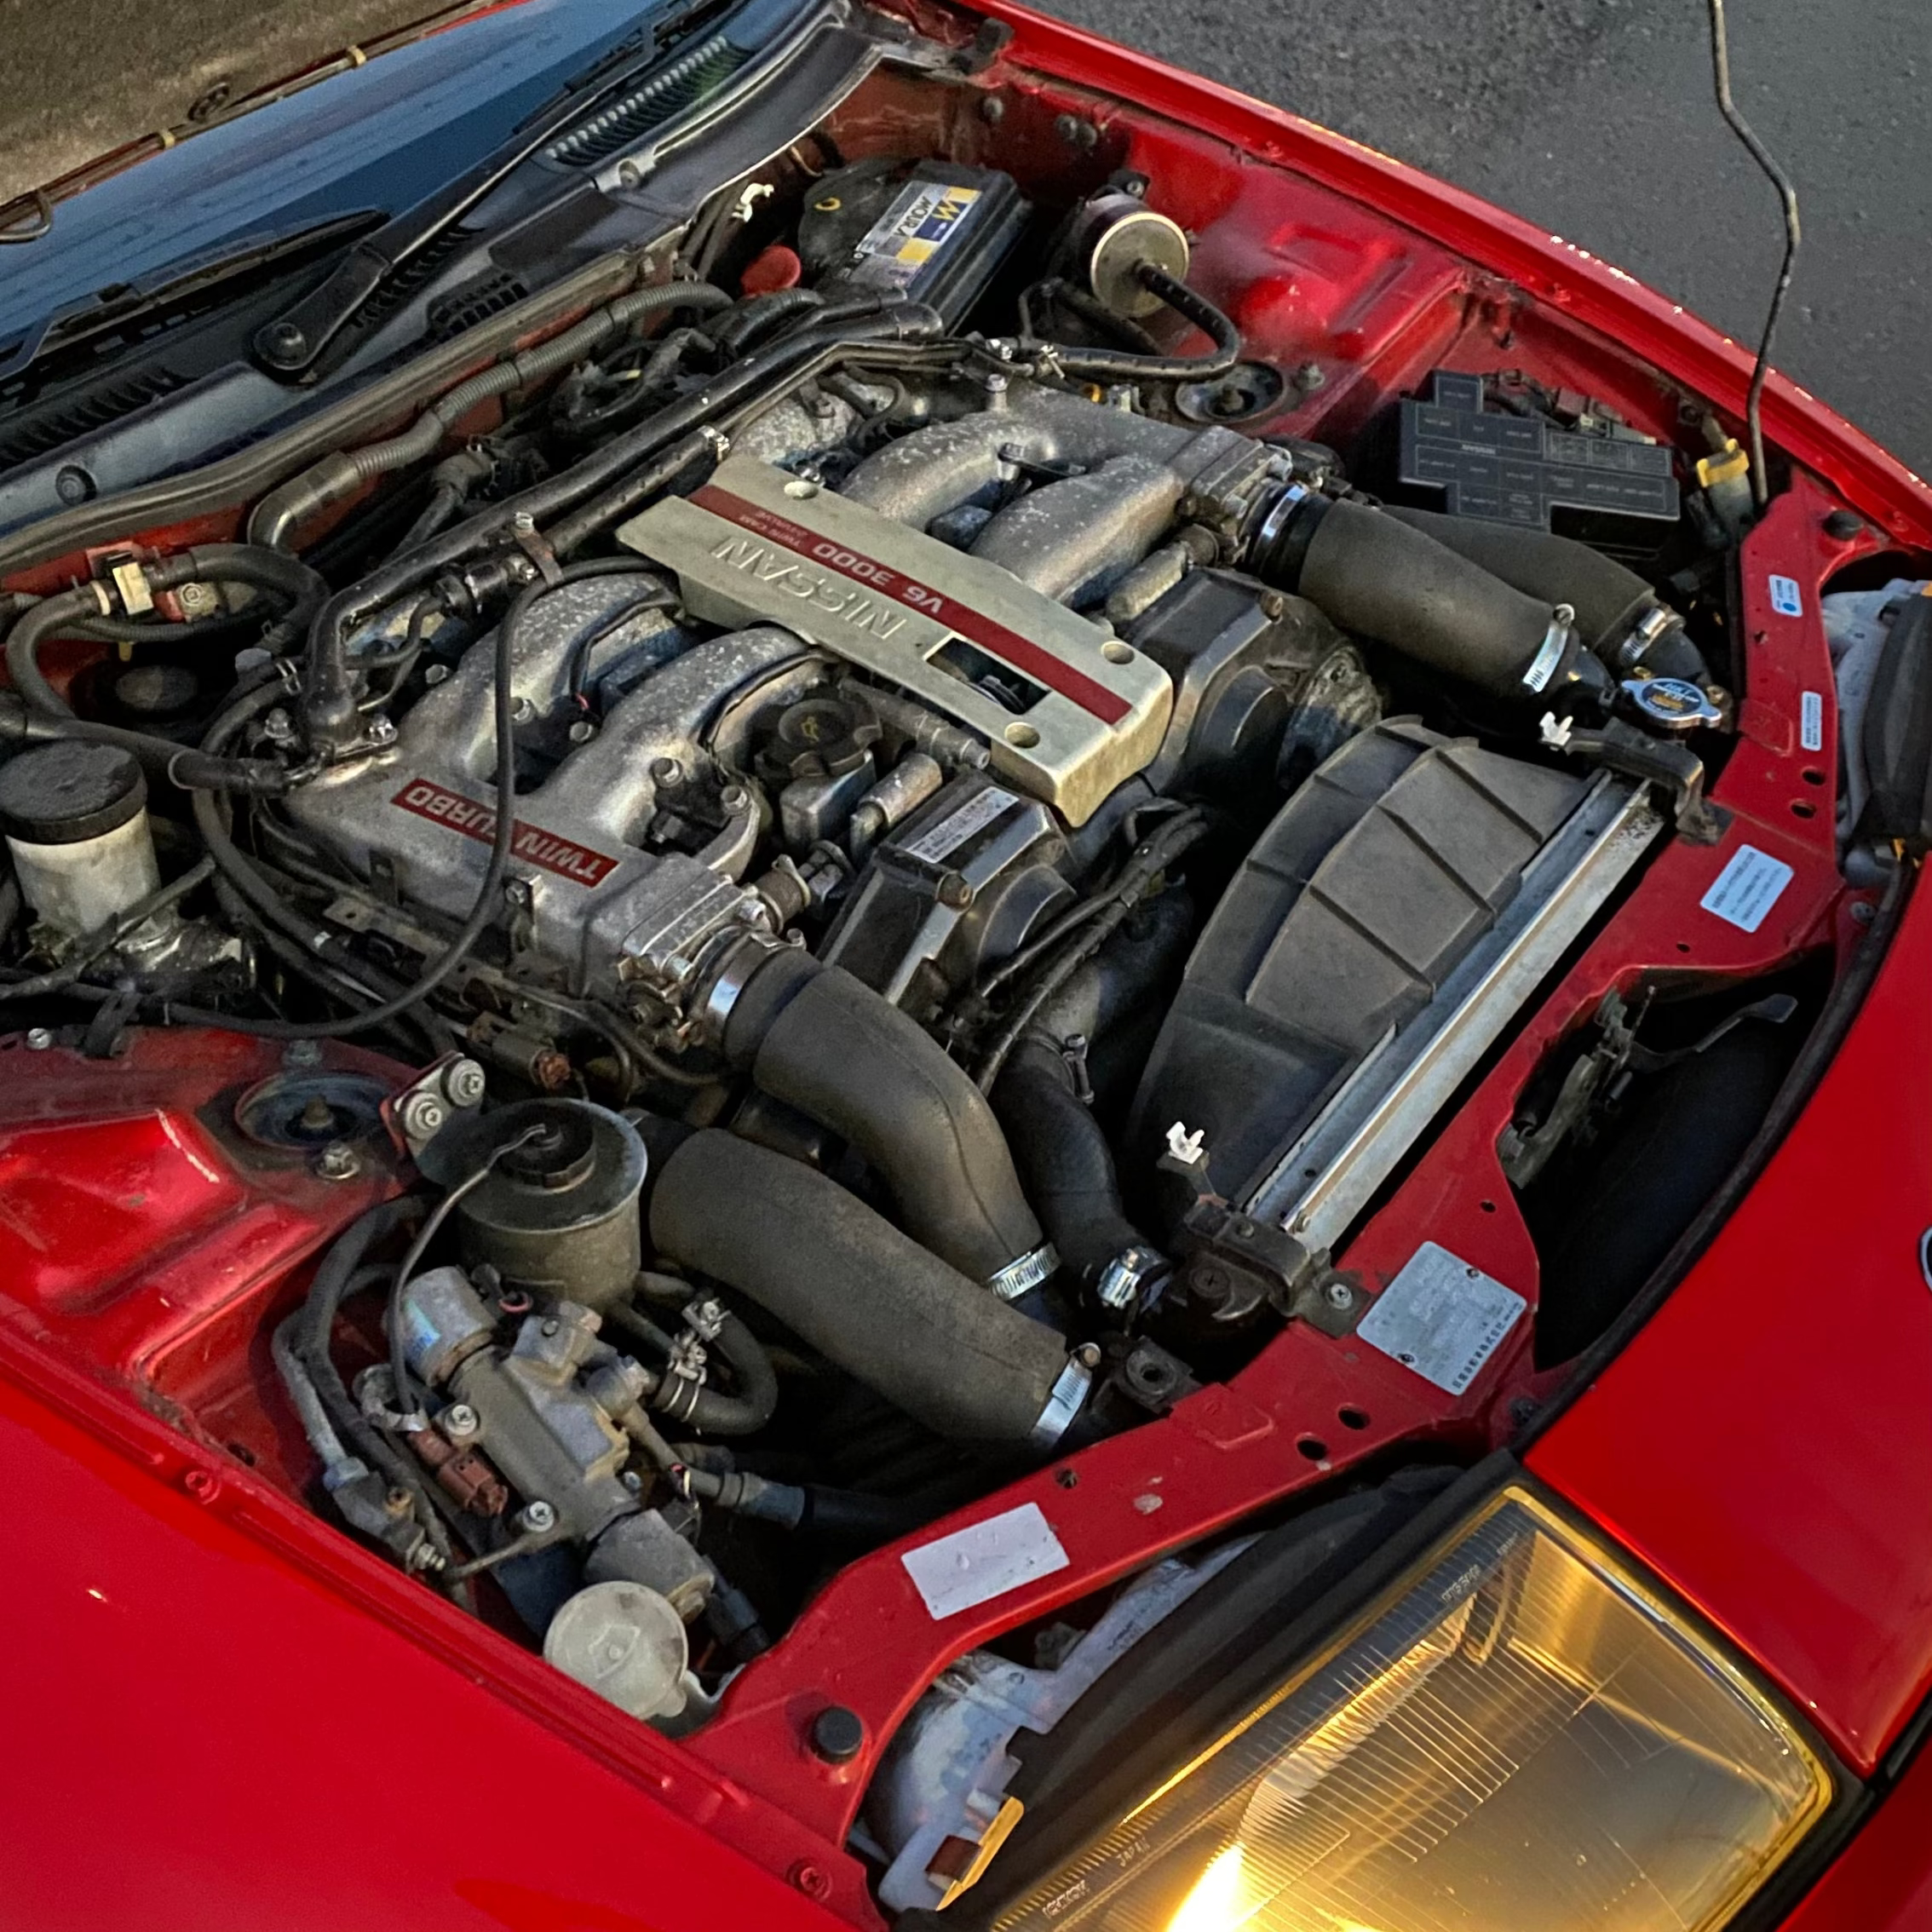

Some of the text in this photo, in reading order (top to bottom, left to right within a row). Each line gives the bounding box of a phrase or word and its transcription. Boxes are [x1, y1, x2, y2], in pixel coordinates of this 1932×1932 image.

[893, 196, 932, 238] MOURA
[710, 538, 907, 640] NISSAN
[812, 542, 944, 613] V6 3000
[405, 786, 602, 879] TWIN URBO
